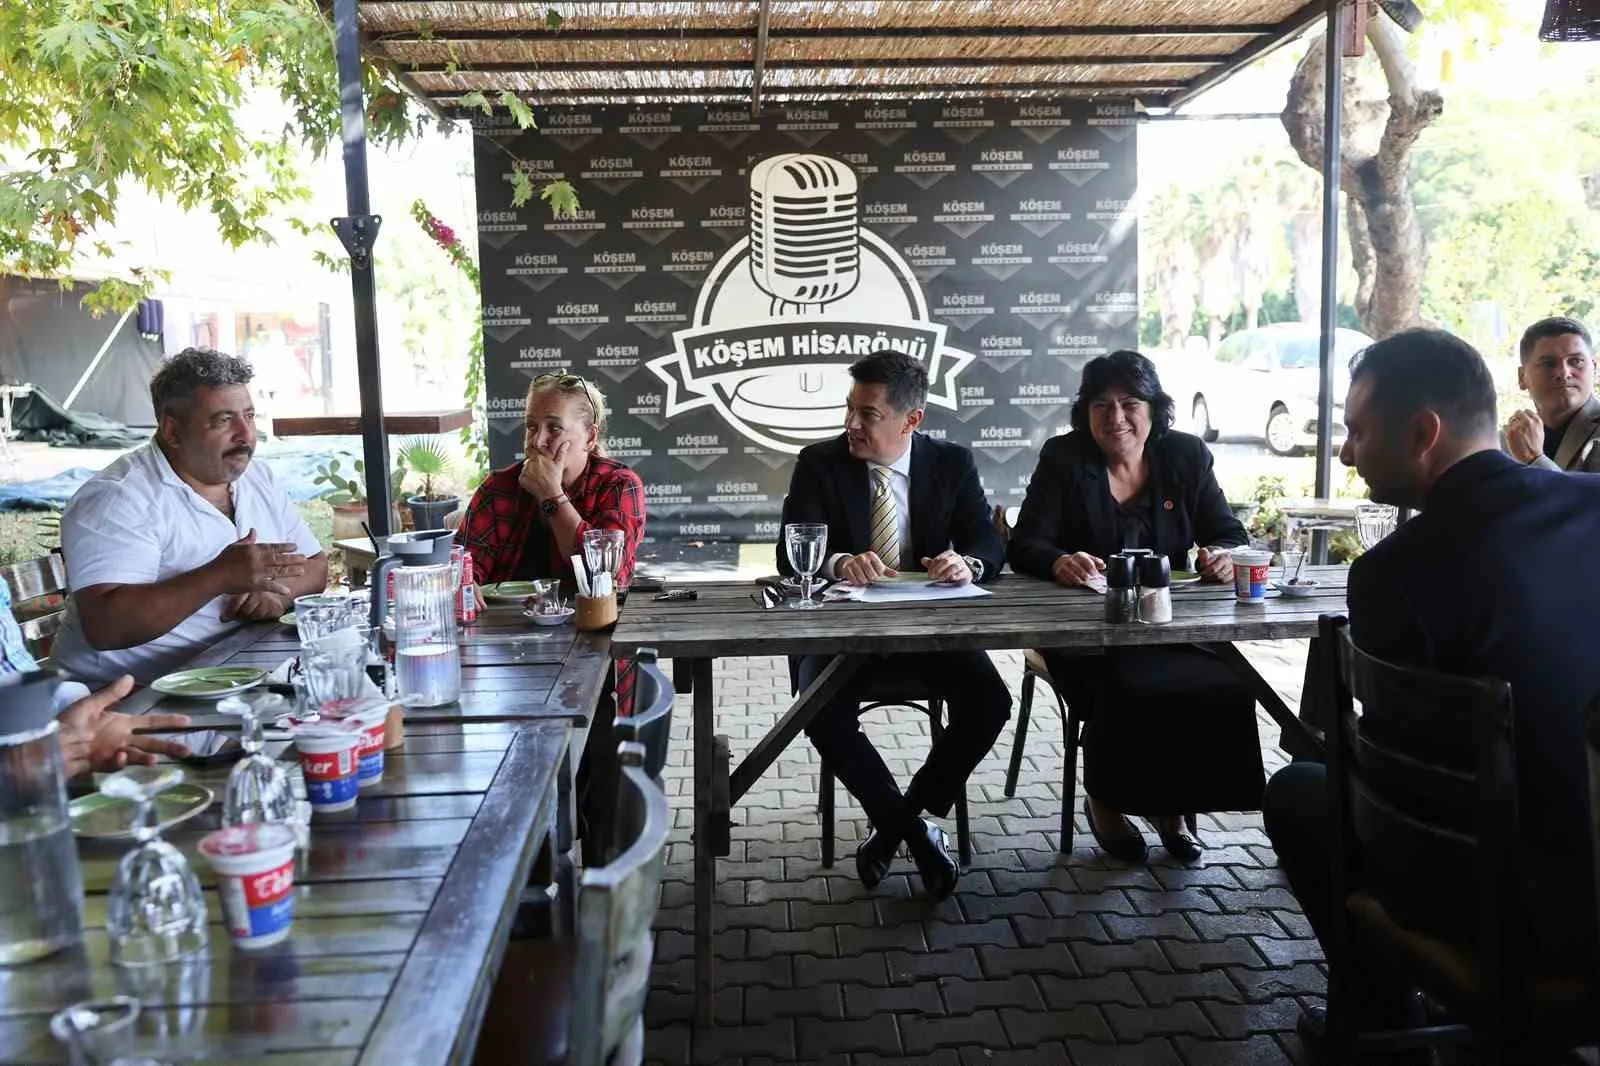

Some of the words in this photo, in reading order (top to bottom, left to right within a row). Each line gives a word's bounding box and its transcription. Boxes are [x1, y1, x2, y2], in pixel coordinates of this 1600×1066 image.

[710, 206, 744, 219] KÖŞE
[694, 339, 785, 366] KÖŞEM
[792, 329, 927, 360] HİSARÖNÜ
[961, 386, 984, 399] ŞEM
[637, 394, 661, 407] KÖŞ
